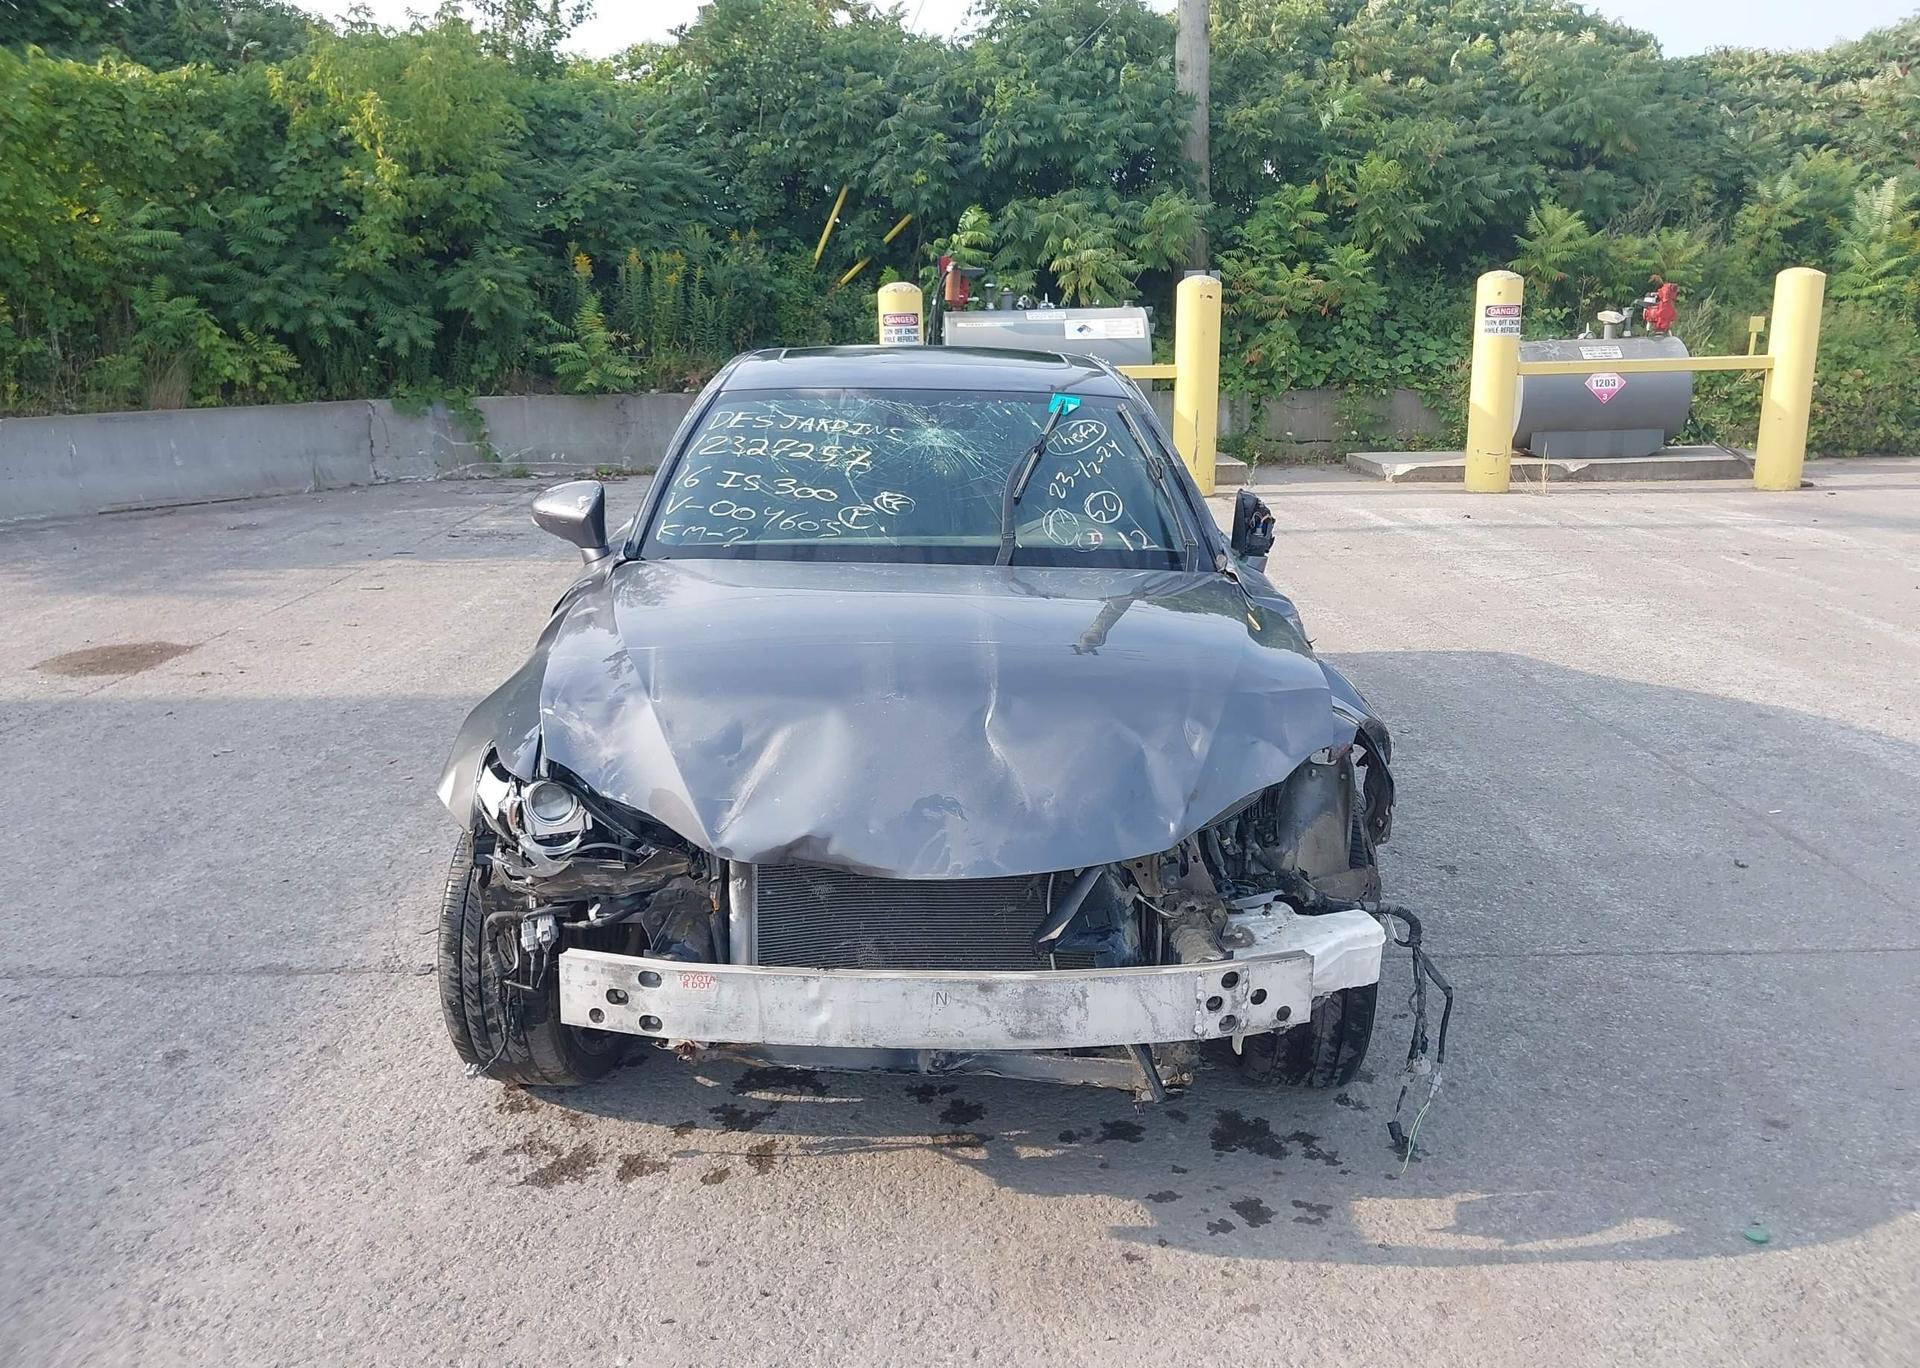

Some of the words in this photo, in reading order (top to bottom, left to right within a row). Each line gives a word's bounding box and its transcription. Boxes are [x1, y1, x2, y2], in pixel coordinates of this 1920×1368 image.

[1490, 307, 1520, 315] DANGER
[886, 315, 915, 324] DANGER
[1595, 379, 1616, 387] 1203
[674, 464, 712, 488] 16
[773, 478, 838, 502] 300
[678, 974, 716, 982] TOYOTA
